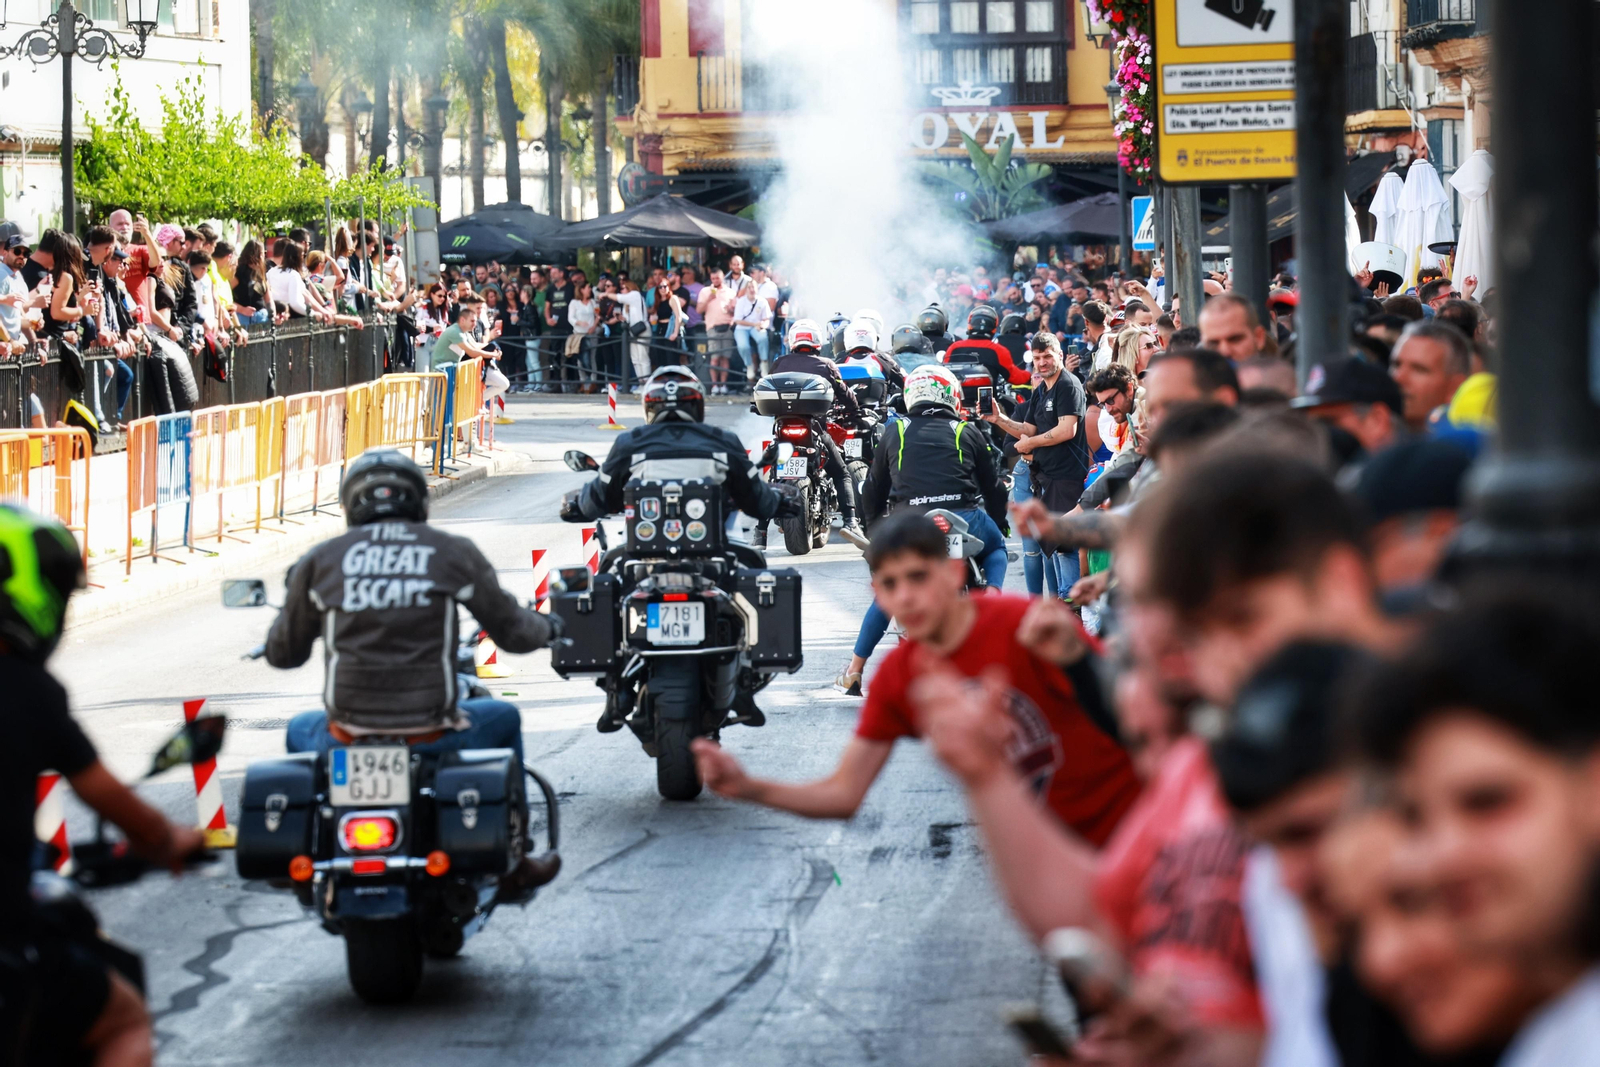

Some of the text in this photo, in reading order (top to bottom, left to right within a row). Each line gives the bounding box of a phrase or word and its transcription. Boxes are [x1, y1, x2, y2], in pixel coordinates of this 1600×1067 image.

[910, 111, 1065, 150] OYAL
[1206, 156, 1237, 166] Puerto
[845, 440, 861, 448] 594
[783, 467, 800, 476] JSV
[909, 493, 962, 506] alpinestars
[361, 520, 419, 541] THE
[341, 540, 437, 577] GREAT
[341, 576, 436, 613] ESCAPE
[660, 606, 700, 622] 7181
[661, 622, 691, 638] MGW
[351, 751, 405, 776] 1946
[350, 777, 392, 800] GJJ
